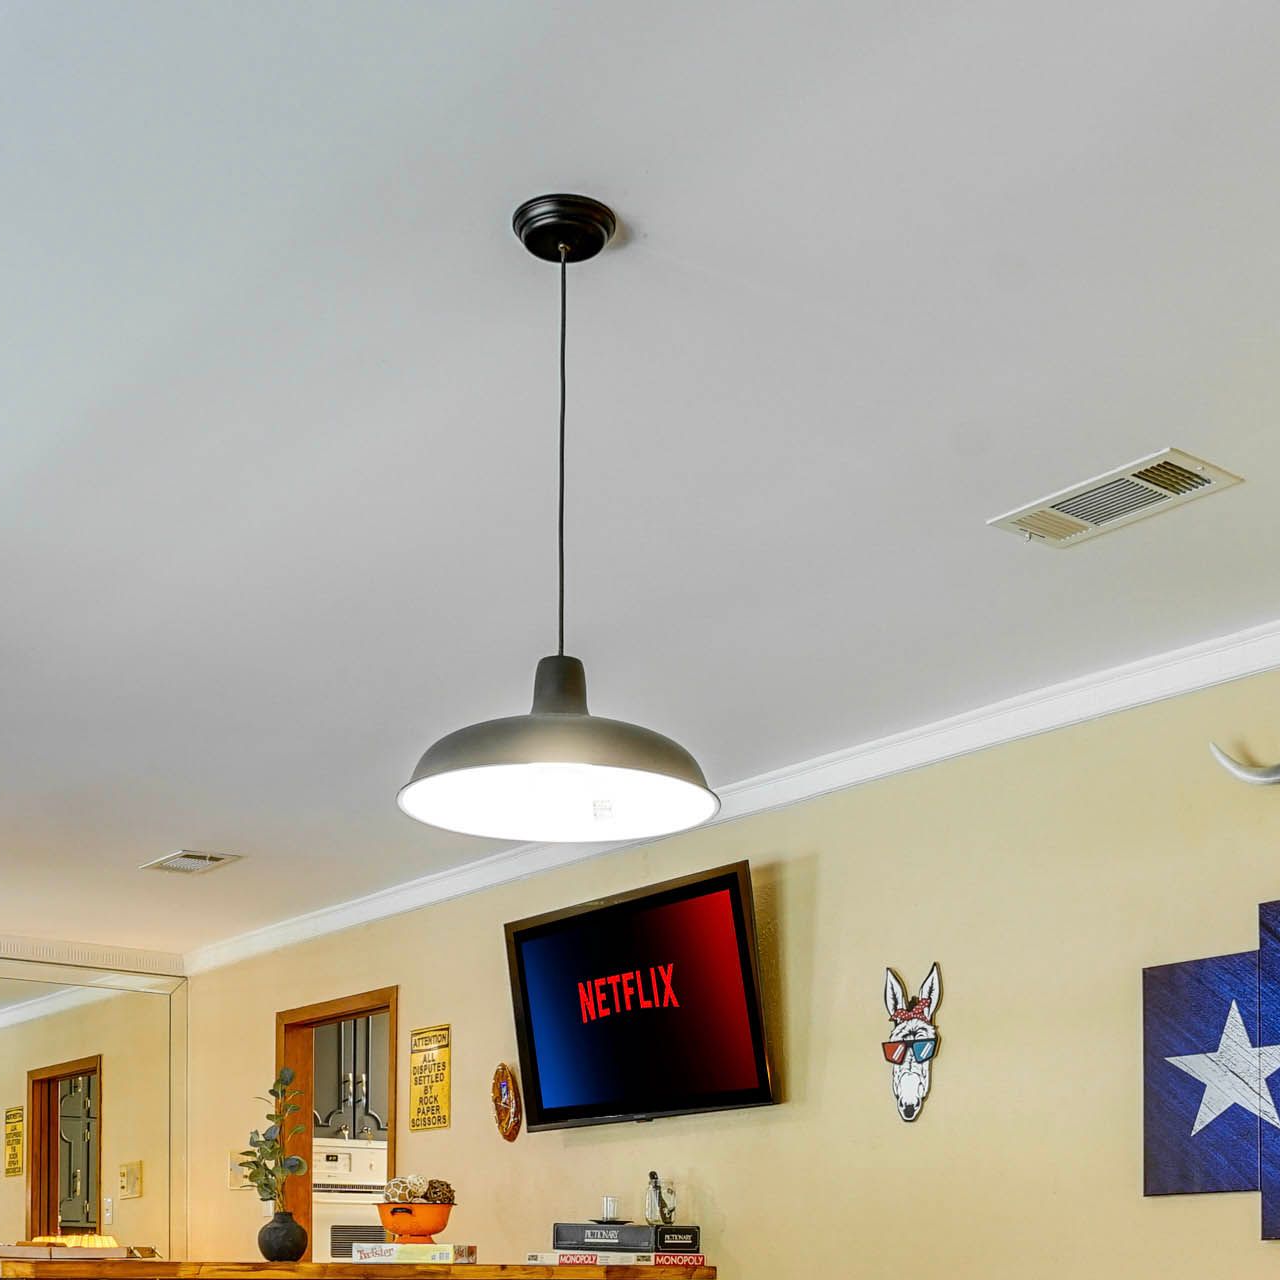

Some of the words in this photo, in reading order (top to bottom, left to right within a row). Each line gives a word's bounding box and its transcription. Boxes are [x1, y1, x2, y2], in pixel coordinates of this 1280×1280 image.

[577, 963, 680, 1024] NETFLIX
[413, 1033, 447, 1047] ATTENTION
[423, 1053, 435, 1063] ALL
[413, 1062, 446, 1075] DISPUTES
[414, 1073, 444, 1086] SETTLED
[423, 1085, 433, 1095] BY
[419, 1095, 439, 1105] ROCK
[417, 1105, 440, 1116] PAPER
[411, 1115, 447, 1127] SCISSORS
[584, 1229, 619, 1239] PICTIONARY
[559, 1254, 597, 1264] MONOPOLY
[655, 1254, 704, 1265] MONOPOLY
